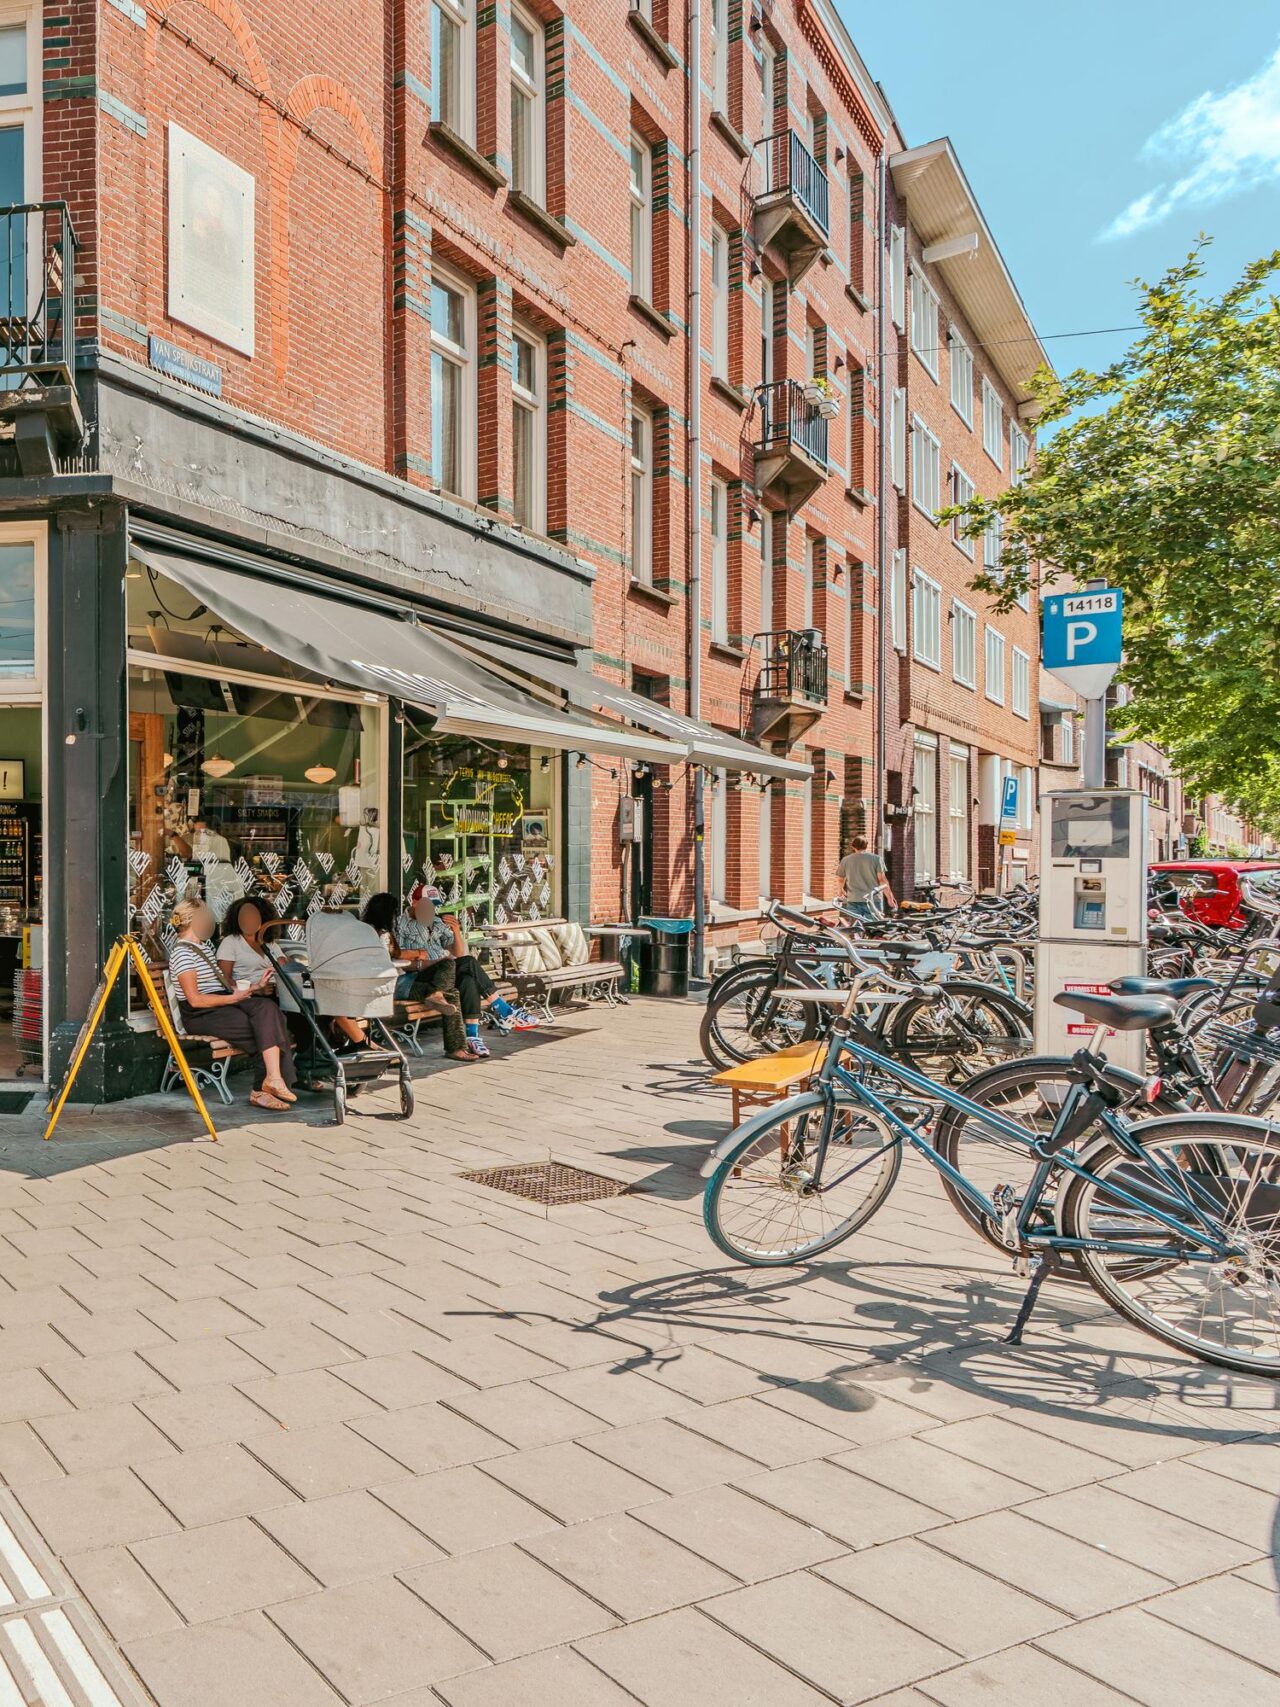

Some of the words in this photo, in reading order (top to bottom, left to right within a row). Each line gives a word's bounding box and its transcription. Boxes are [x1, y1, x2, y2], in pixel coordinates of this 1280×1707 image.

[153, 341, 170, 359] VAN
[173, 350, 219, 381] SPEIJKSTRAAT
[1067, 597, 1113, 612] 14118
[1066, 621, 1098, 661] P
[3, 772, 7, 787] !
[1006, 780, 1016, 800] P
[235, 856, 257, 893] STACH
[292, 857, 313, 892] STACH
[141, 883, 166, 924] STACH
